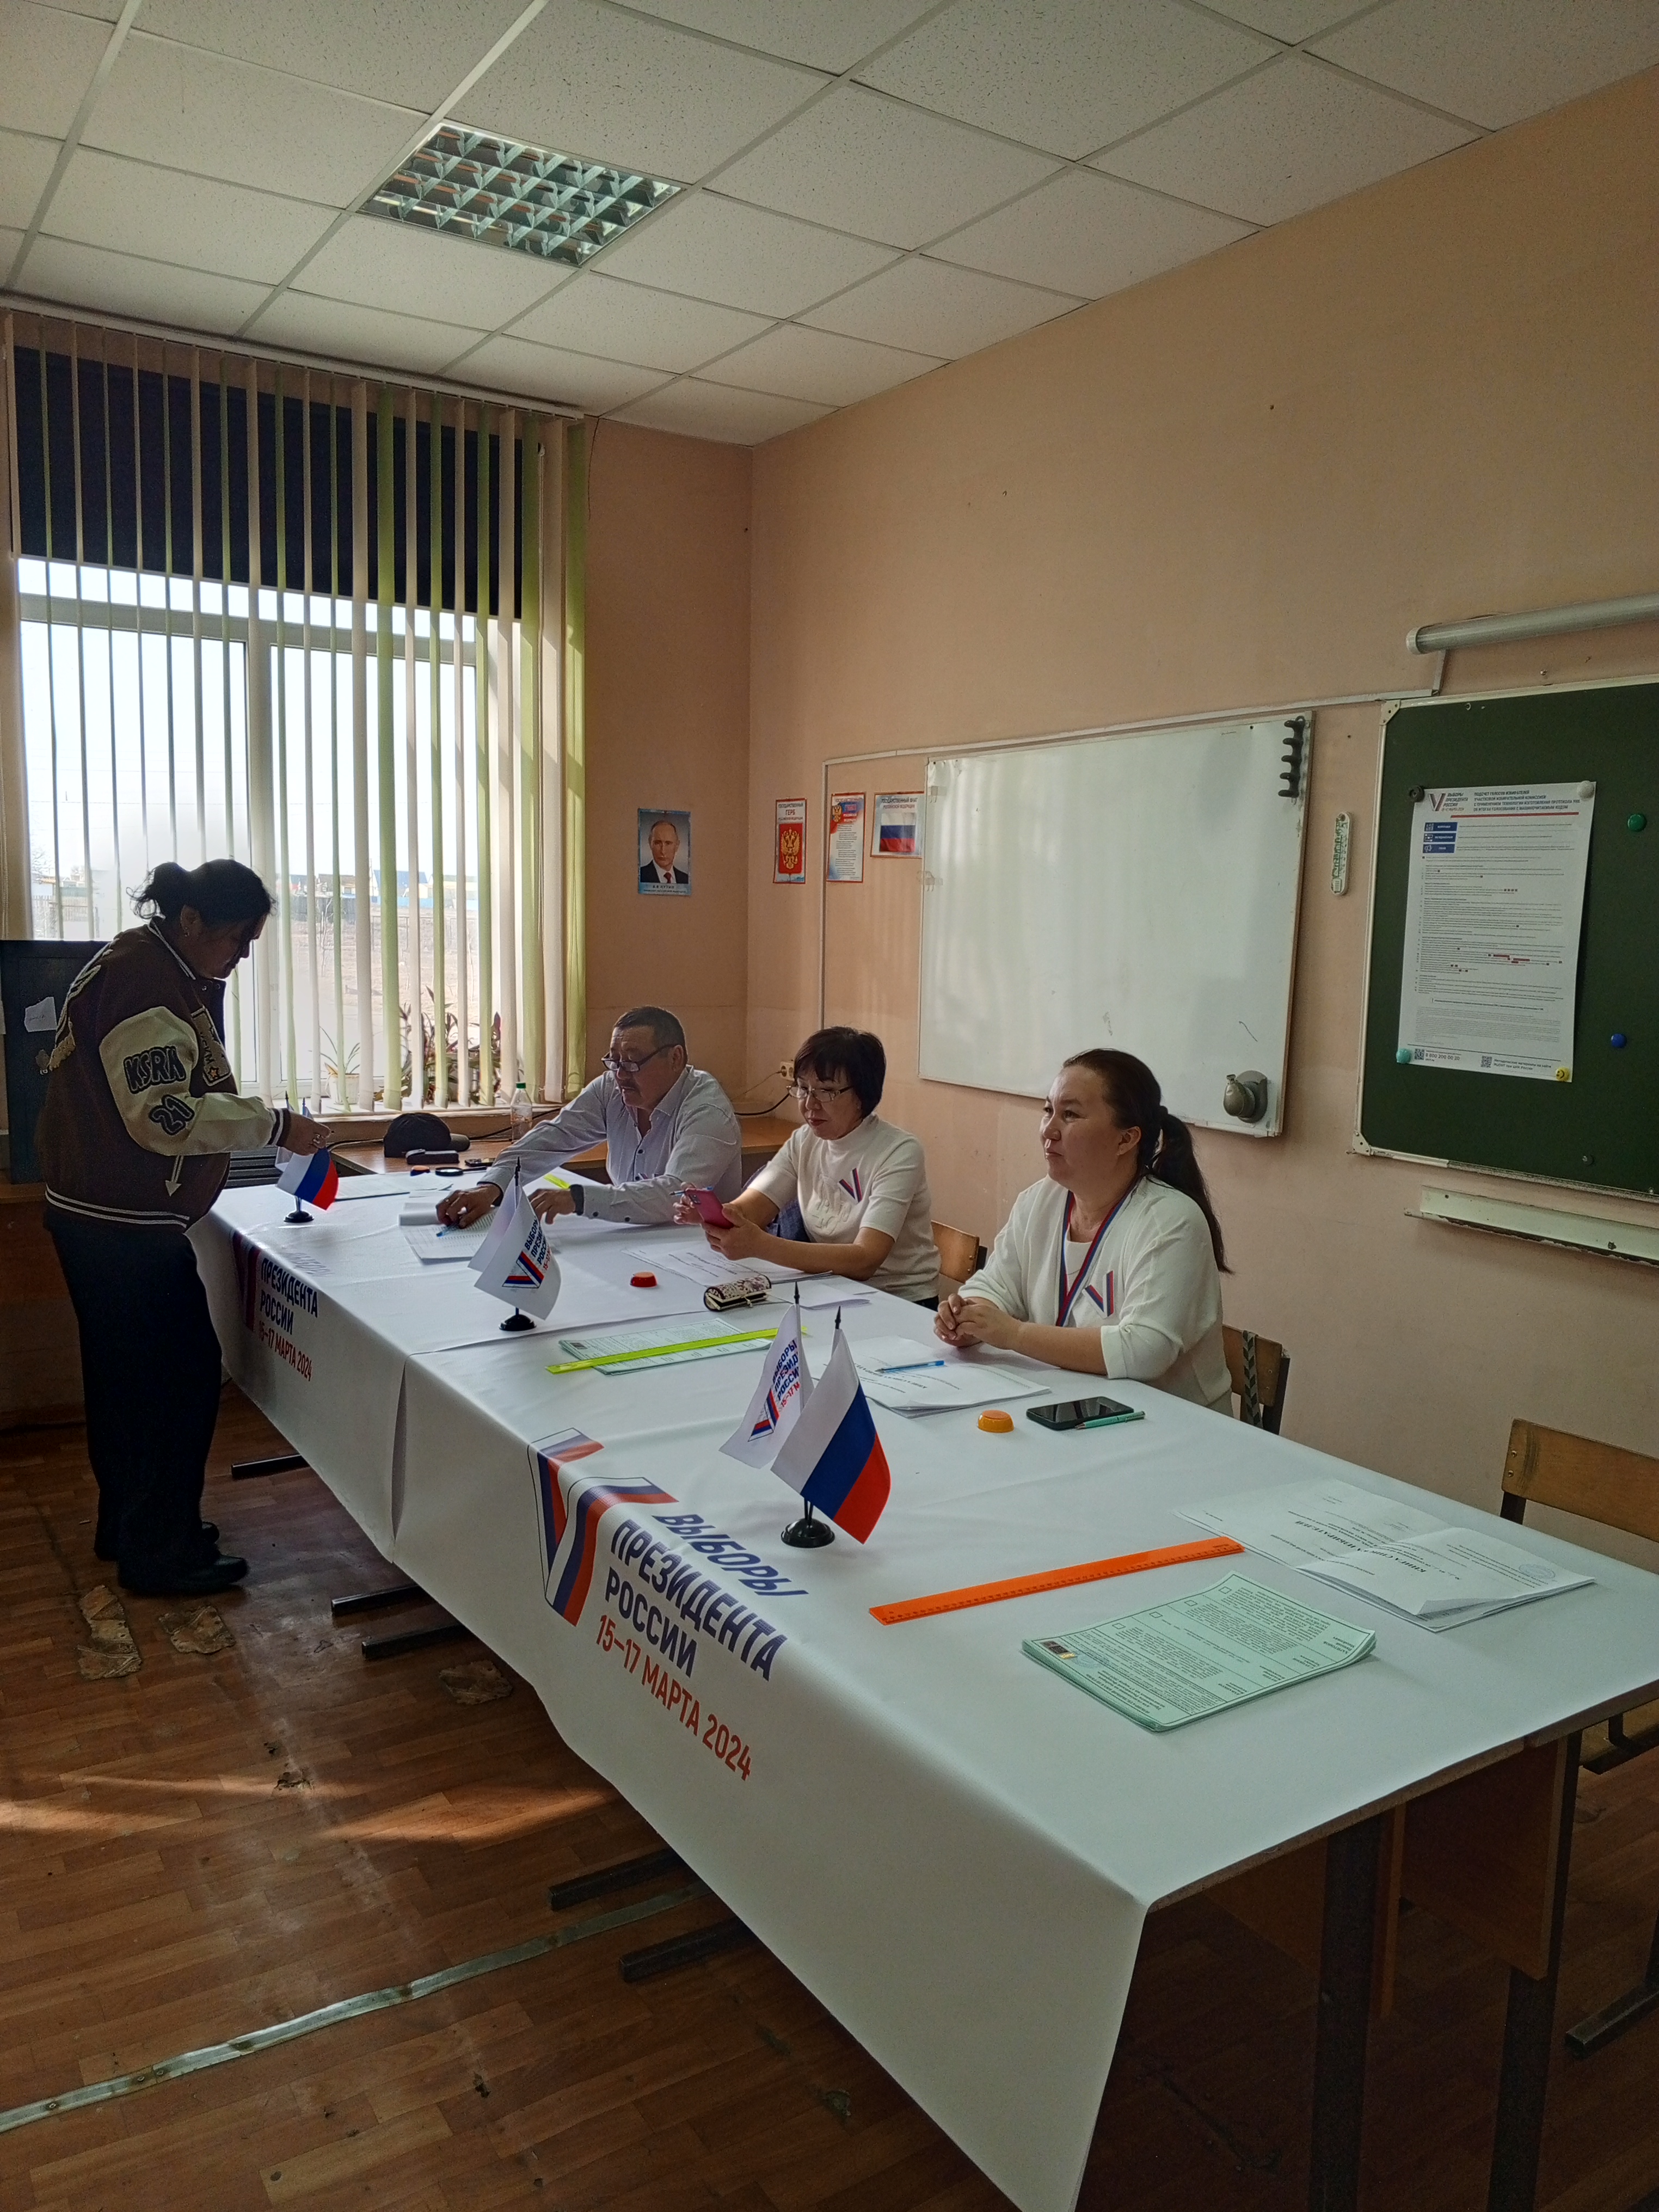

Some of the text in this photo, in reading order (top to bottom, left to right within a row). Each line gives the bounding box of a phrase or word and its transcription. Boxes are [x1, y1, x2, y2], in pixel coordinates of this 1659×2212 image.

[149, 1094, 195, 1135] 21
[260, 1289, 293, 1335] РОССИИ
[261, 1258, 317, 1318] ПРЕЗИДЕНТА
[275, 1332, 296, 1368] МАРТА
[297, 1350, 312, 1381] 2024
[772, 1340, 797, 1384] ВЫБОРЫ
[775, 1351, 798, 1392] ПРЕЗИД
[652, 1514, 808, 1596] ВЫБОРЫ
[605, 1566, 697, 1678] РОССИИ
[611, 1519, 788, 1681] ПРЕЗИДЕНТА
[642, 1655, 700, 1736] МАРТА
[702, 1714, 751, 1780] 2024
